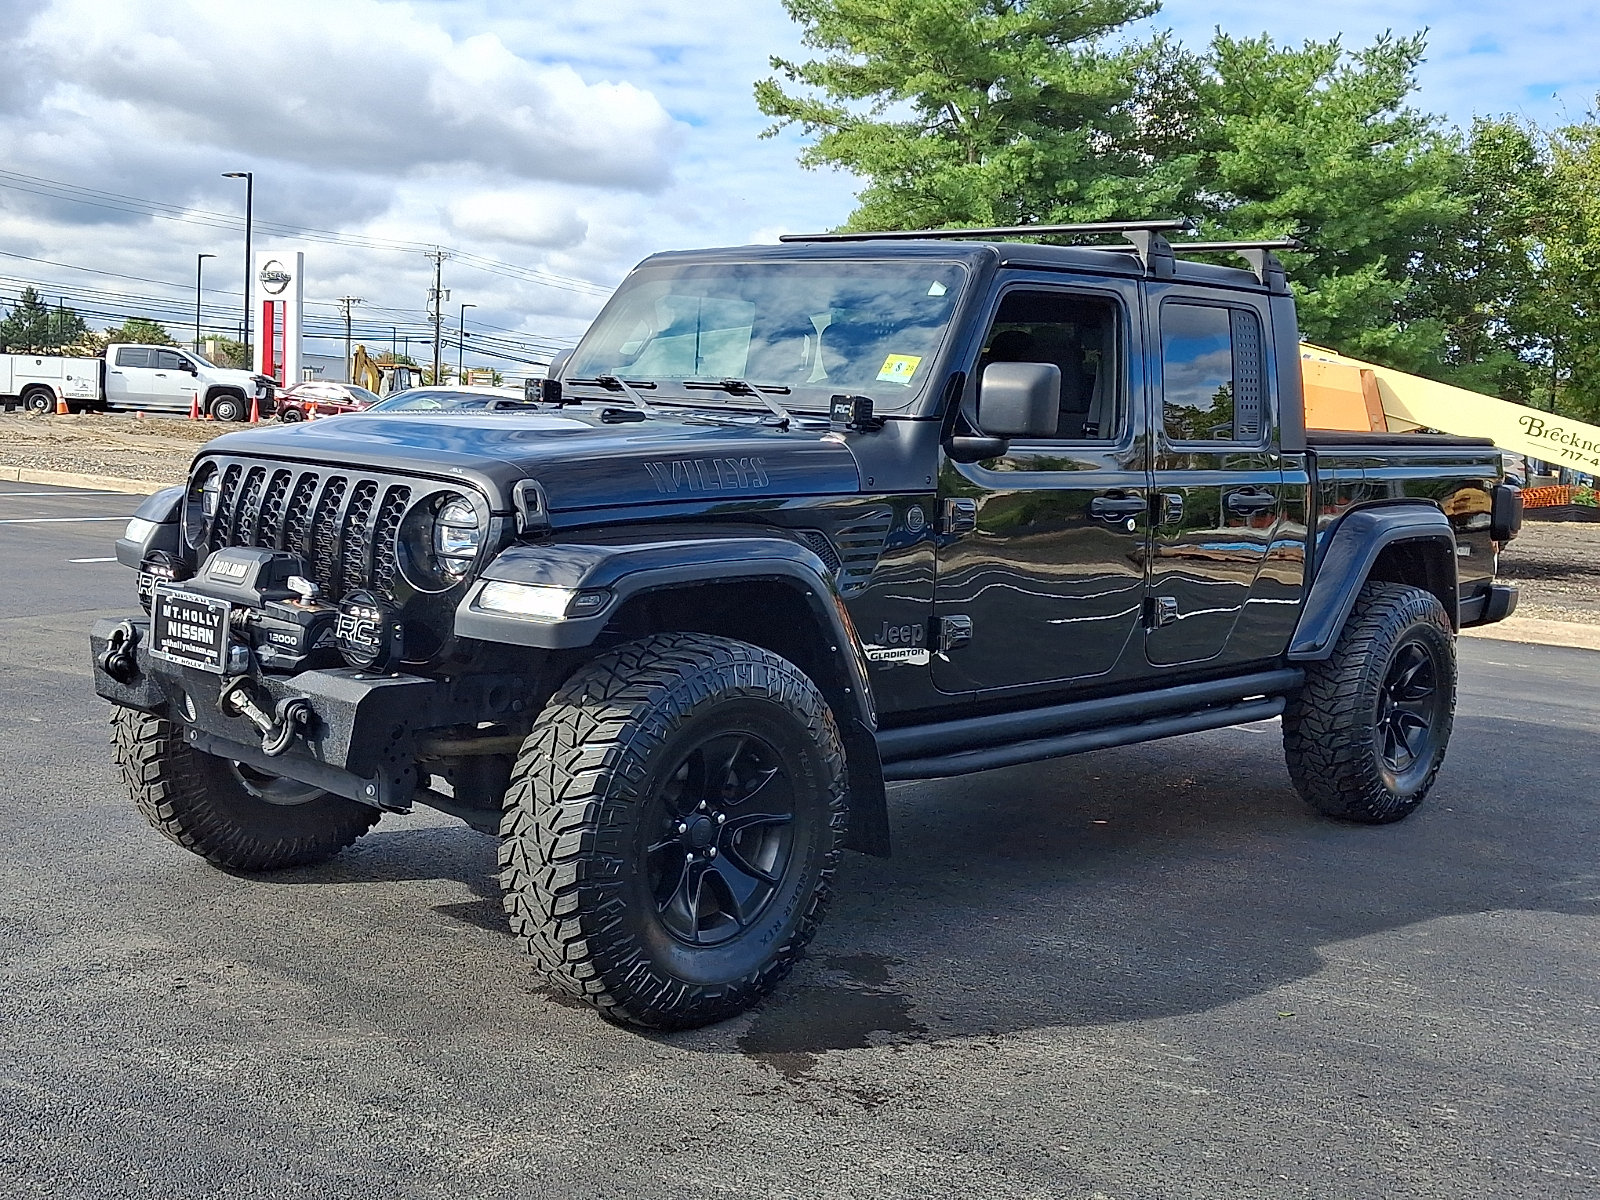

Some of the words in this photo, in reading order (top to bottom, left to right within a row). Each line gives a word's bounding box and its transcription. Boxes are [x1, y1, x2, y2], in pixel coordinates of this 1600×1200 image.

[260, 271, 290, 280] NISSAN
[834, 404, 850, 414] RC
[643, 457, 770, 493] WILLYS
[167, 620, 214, 645] NISSAN
[268, 632, 298, 646] 12000
[336, 613, 375, 646] RC
[874, 620, 925, 646] Jeep
[870, 648, 925, 660] GLADIATOR
